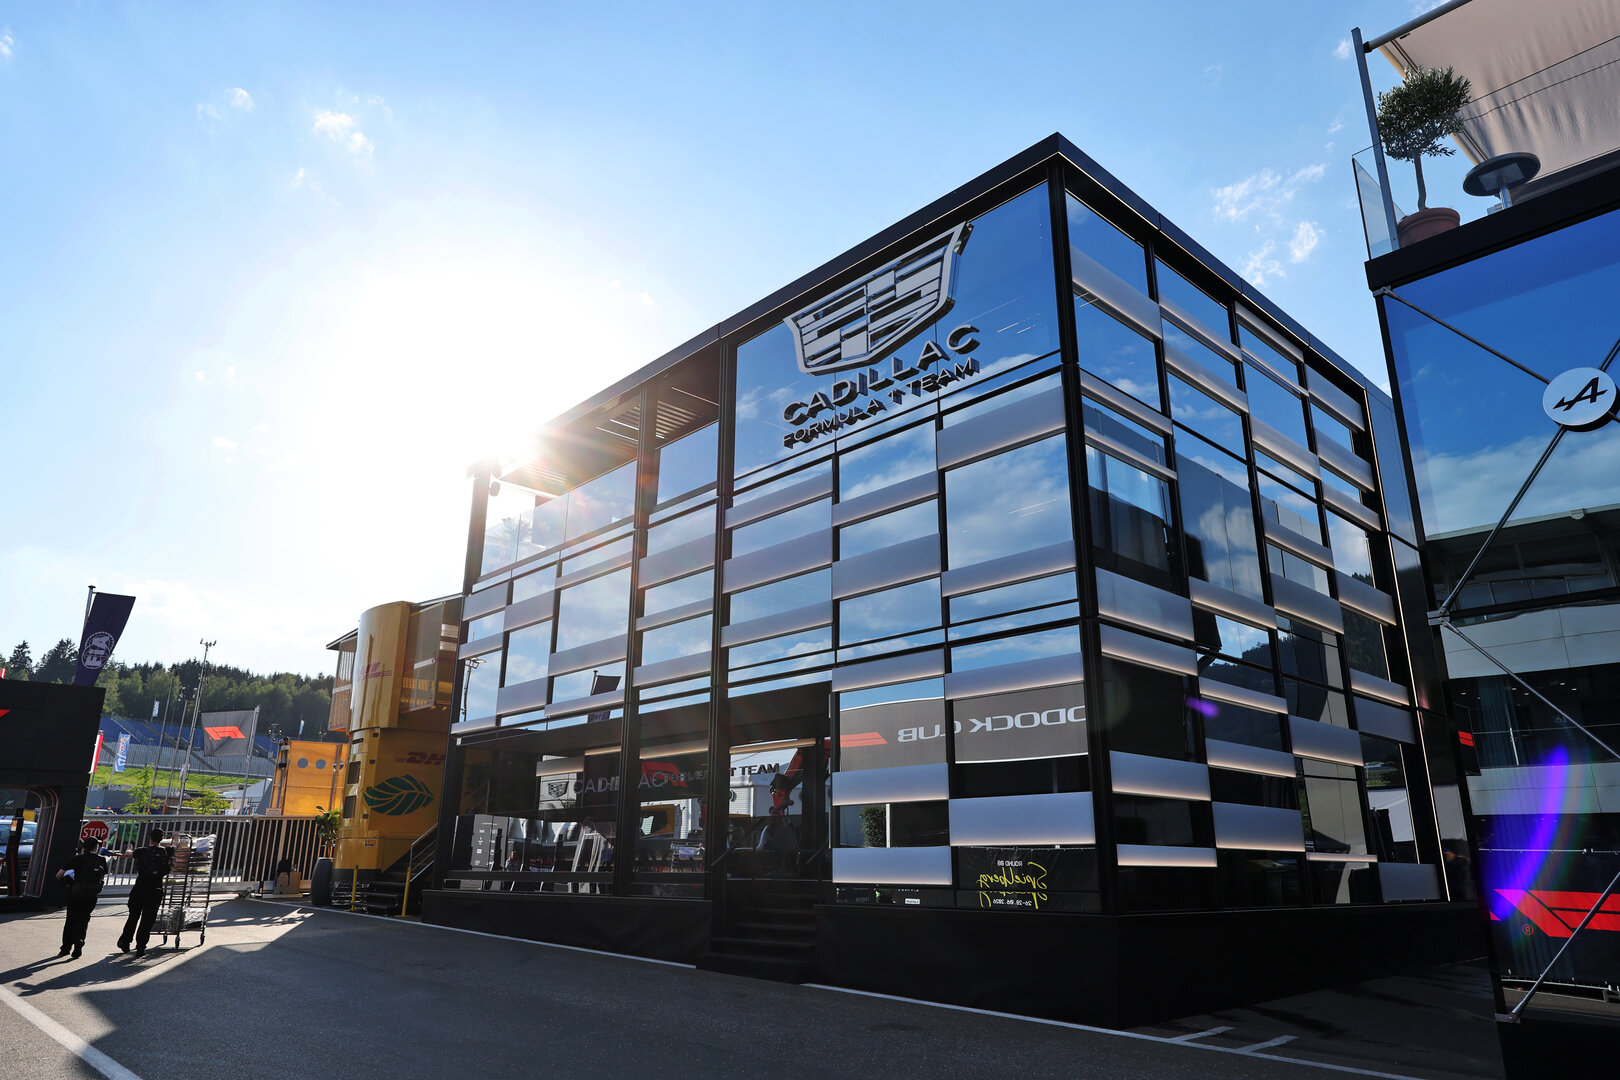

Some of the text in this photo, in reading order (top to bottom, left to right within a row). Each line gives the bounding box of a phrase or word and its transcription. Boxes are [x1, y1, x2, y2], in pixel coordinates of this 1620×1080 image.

[783, 324, 981, 426] CADILLAC
[783, 398, 887, 449] FORMULA
[906, 357, 980, 397] TEAM
[739, 763, 780, 776] TEAM
[82, 827, 107, 838] STOP
